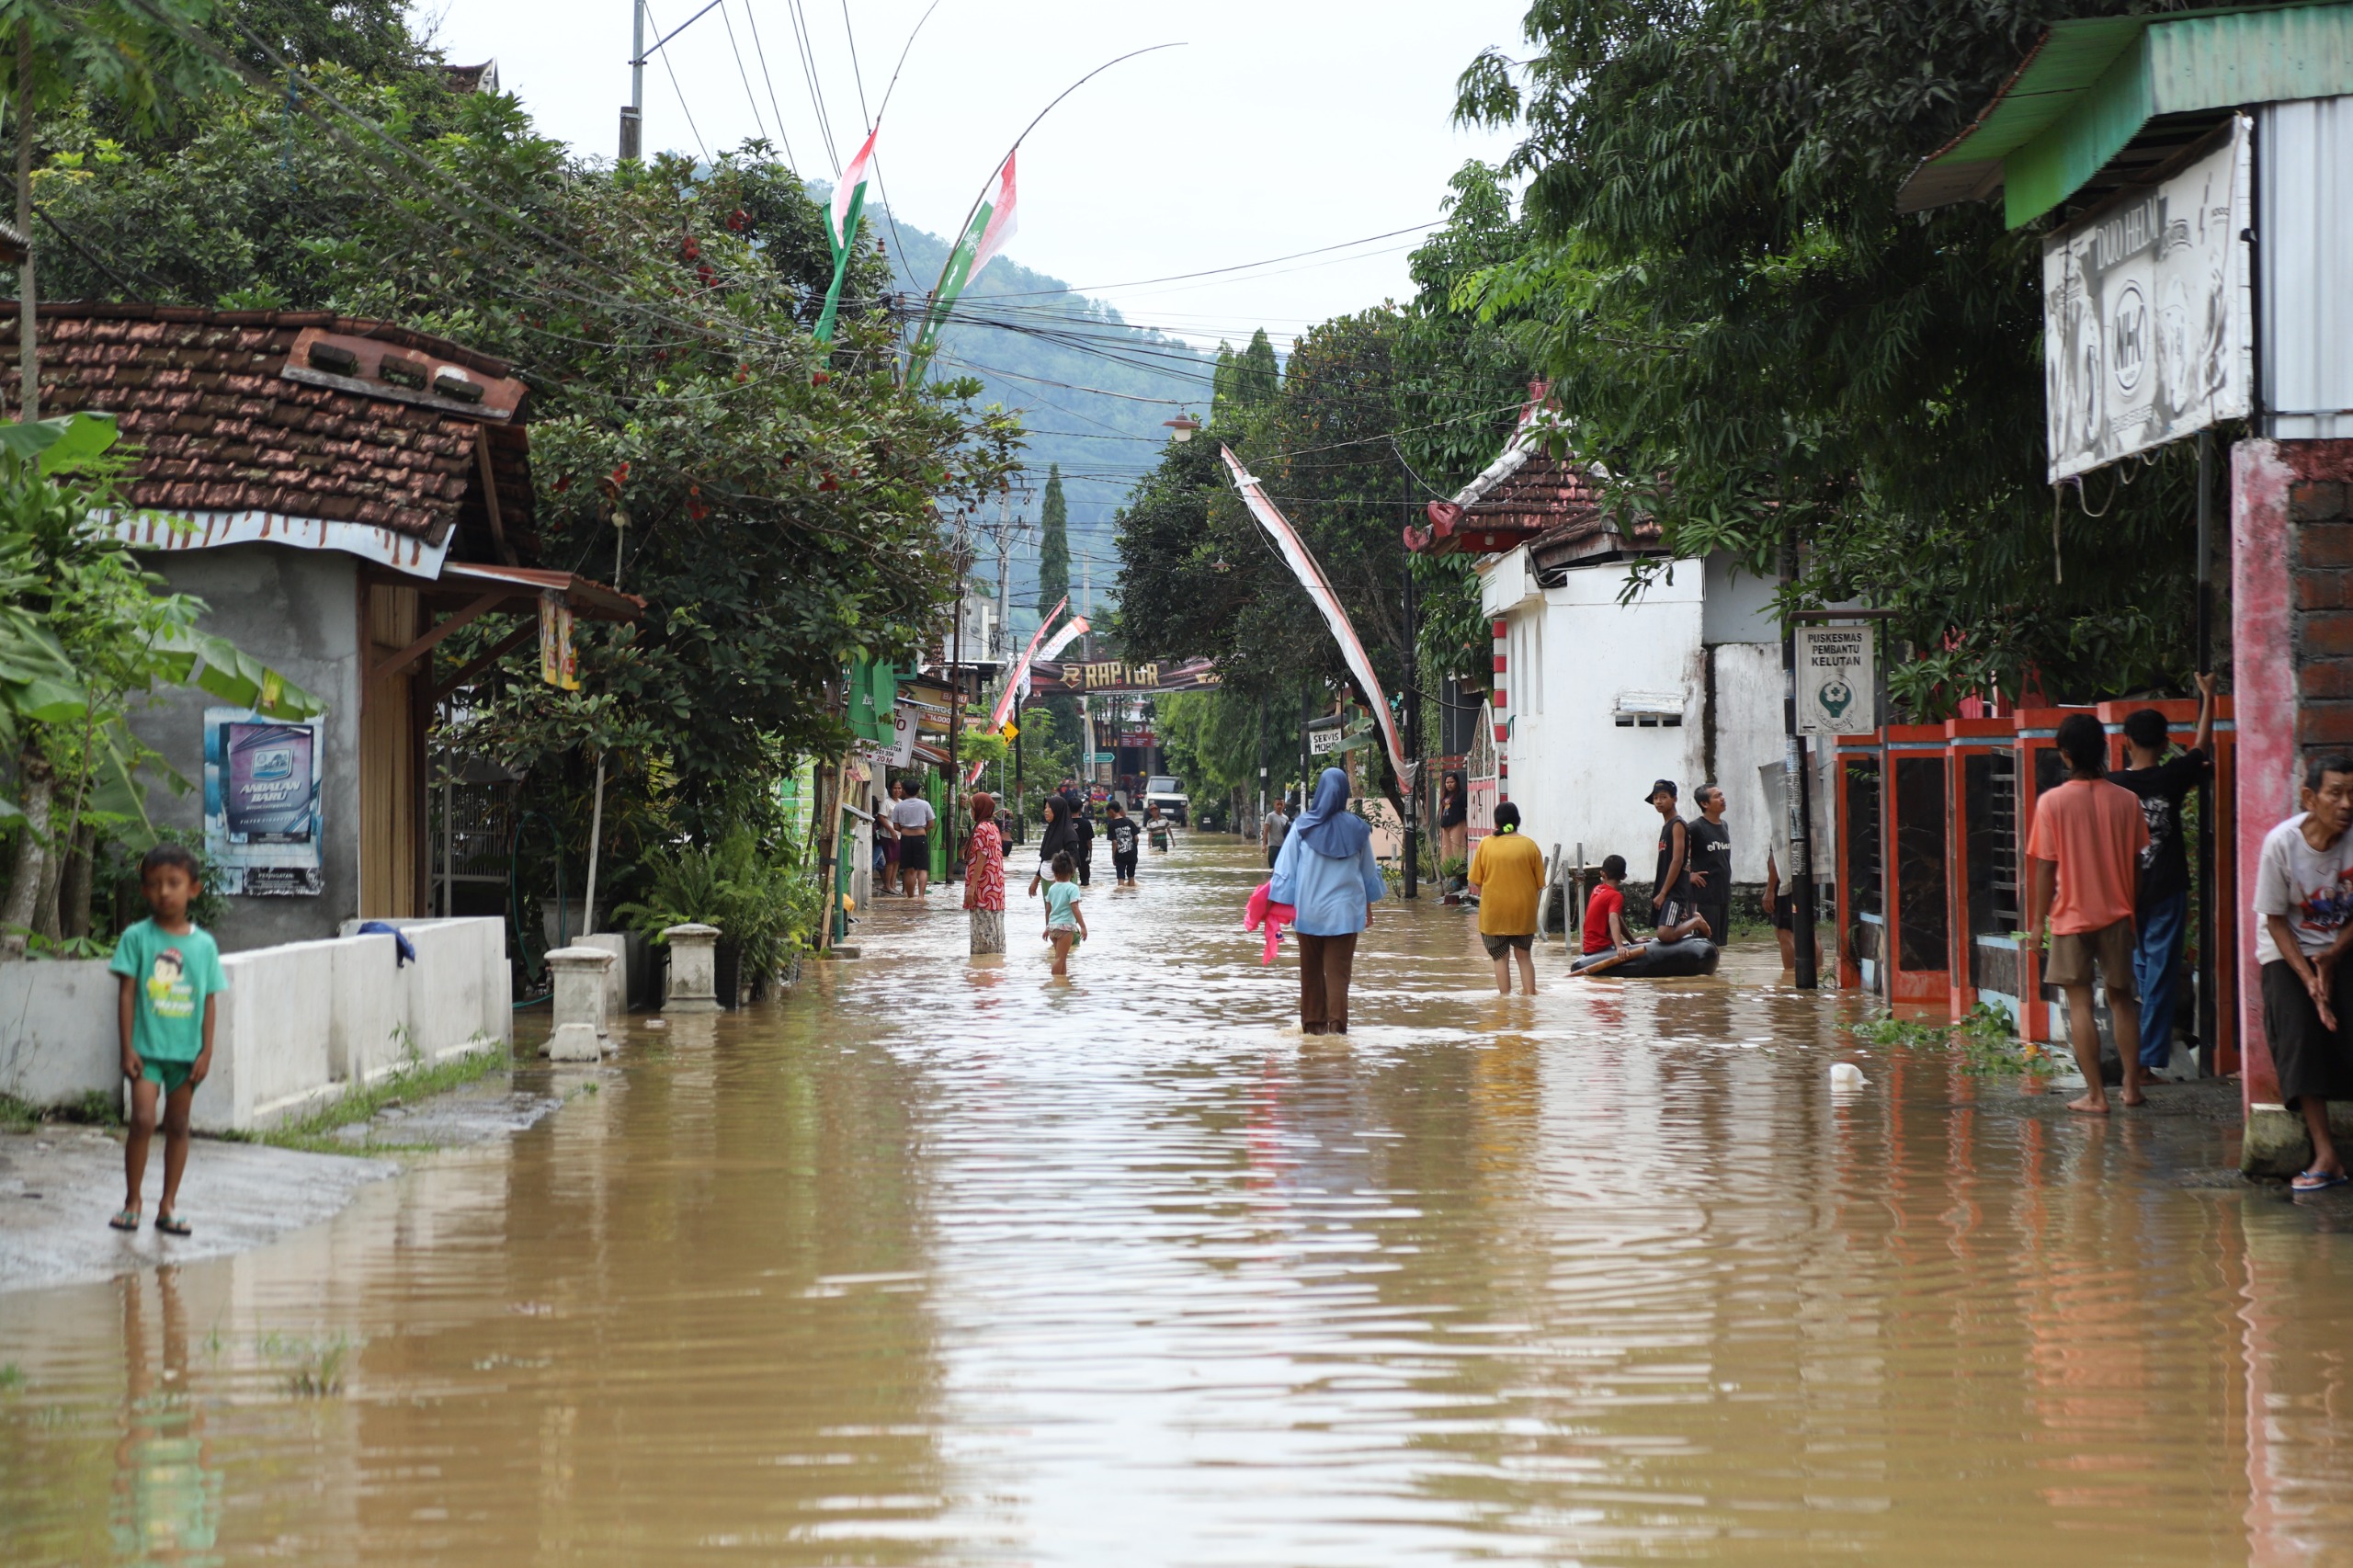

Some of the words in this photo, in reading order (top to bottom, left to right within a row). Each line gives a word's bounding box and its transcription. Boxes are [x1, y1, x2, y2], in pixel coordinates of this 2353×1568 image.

[2097, 219, 2123, 270] DUO
[2125, 194, 2160, 256] HELM
[1808, 632, 1862, 643] PUSKESMAS
[1813, 644, 1859, 655] PEMBANTU
[1812, 656, 1860, 666] KELUTAN
[1313, 733, 1339, 743] SERVIS
[240, 781, 301, 794] ANDALAN
[251, 792, 288, 802] BARU
